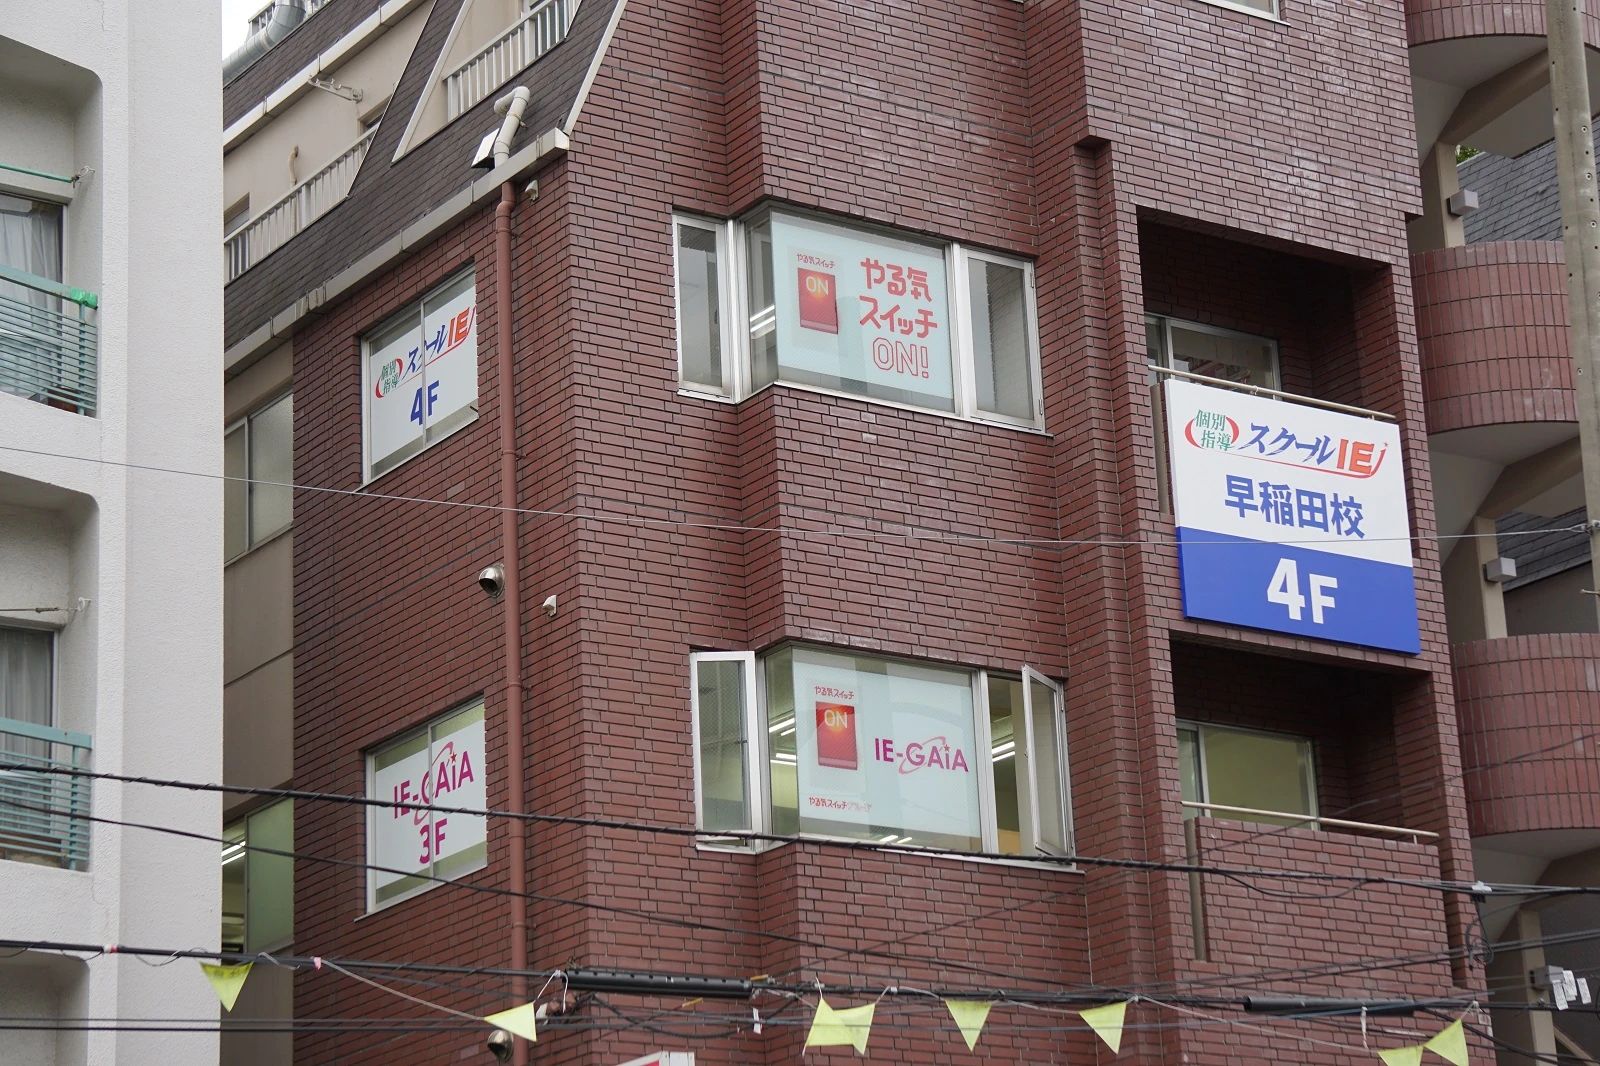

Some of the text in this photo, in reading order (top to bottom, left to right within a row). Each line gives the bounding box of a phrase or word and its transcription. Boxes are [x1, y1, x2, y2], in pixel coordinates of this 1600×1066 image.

[796, 253, 835, 269] やる気スイッチ
[860, 257, 932, 302] やる気
[805, 276, 829, 296] ON
[859, 295, 938, 338] スイッチ
[872, 337, 929, 379] ON!
[410, 380, 439, 426] 4F
[1195, 409, 1227, 432] 個別
[1201, 429, 1232, 452] 指導
[1224, 474, 1365, 539] 早稲田校
[1266, 557, 1338, 625] 4F
[814, 685, 855, 700] やる気スイッチ
[824, 709, 848, 729] ON
[419, 818, 448, 864] 3F
